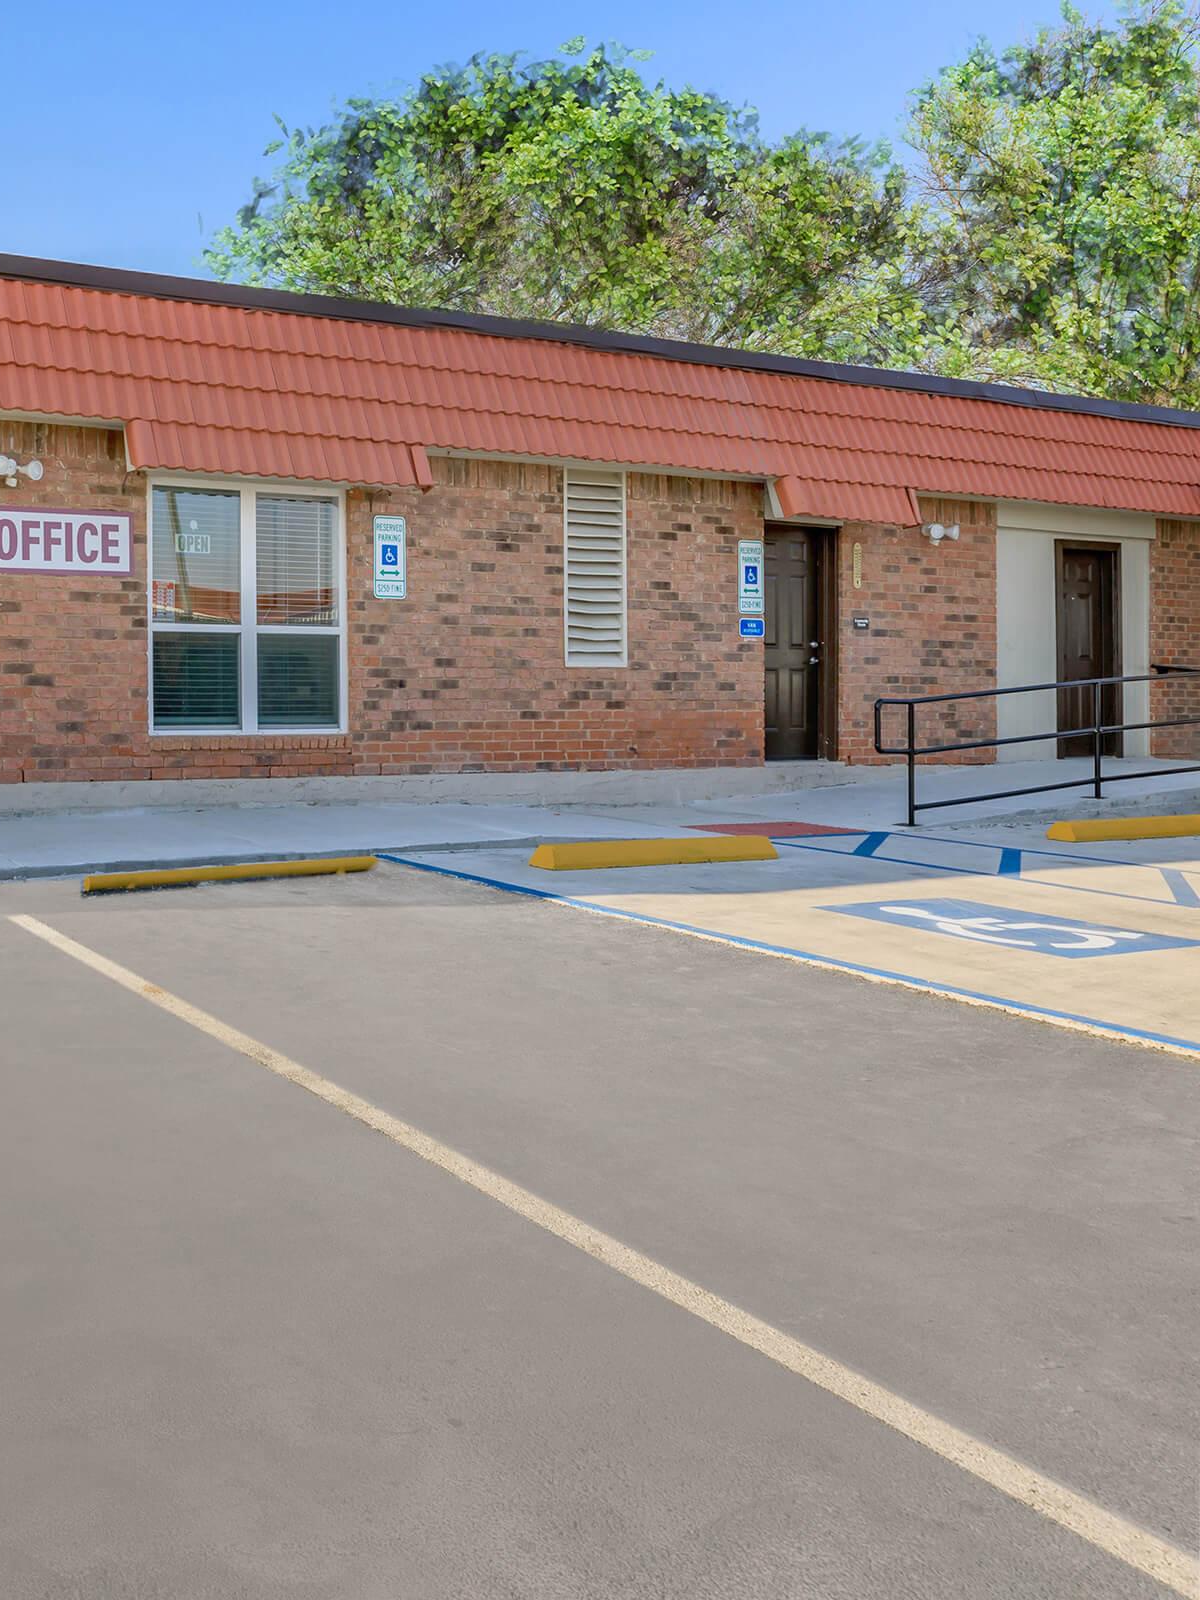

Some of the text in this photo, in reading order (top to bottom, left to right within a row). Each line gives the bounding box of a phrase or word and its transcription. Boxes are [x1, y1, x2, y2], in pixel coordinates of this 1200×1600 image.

[376, 523, 403, 532] RESERVED
[377, 533, 402, 542] PARKING
[177, 535, 209, 553] OPEN
